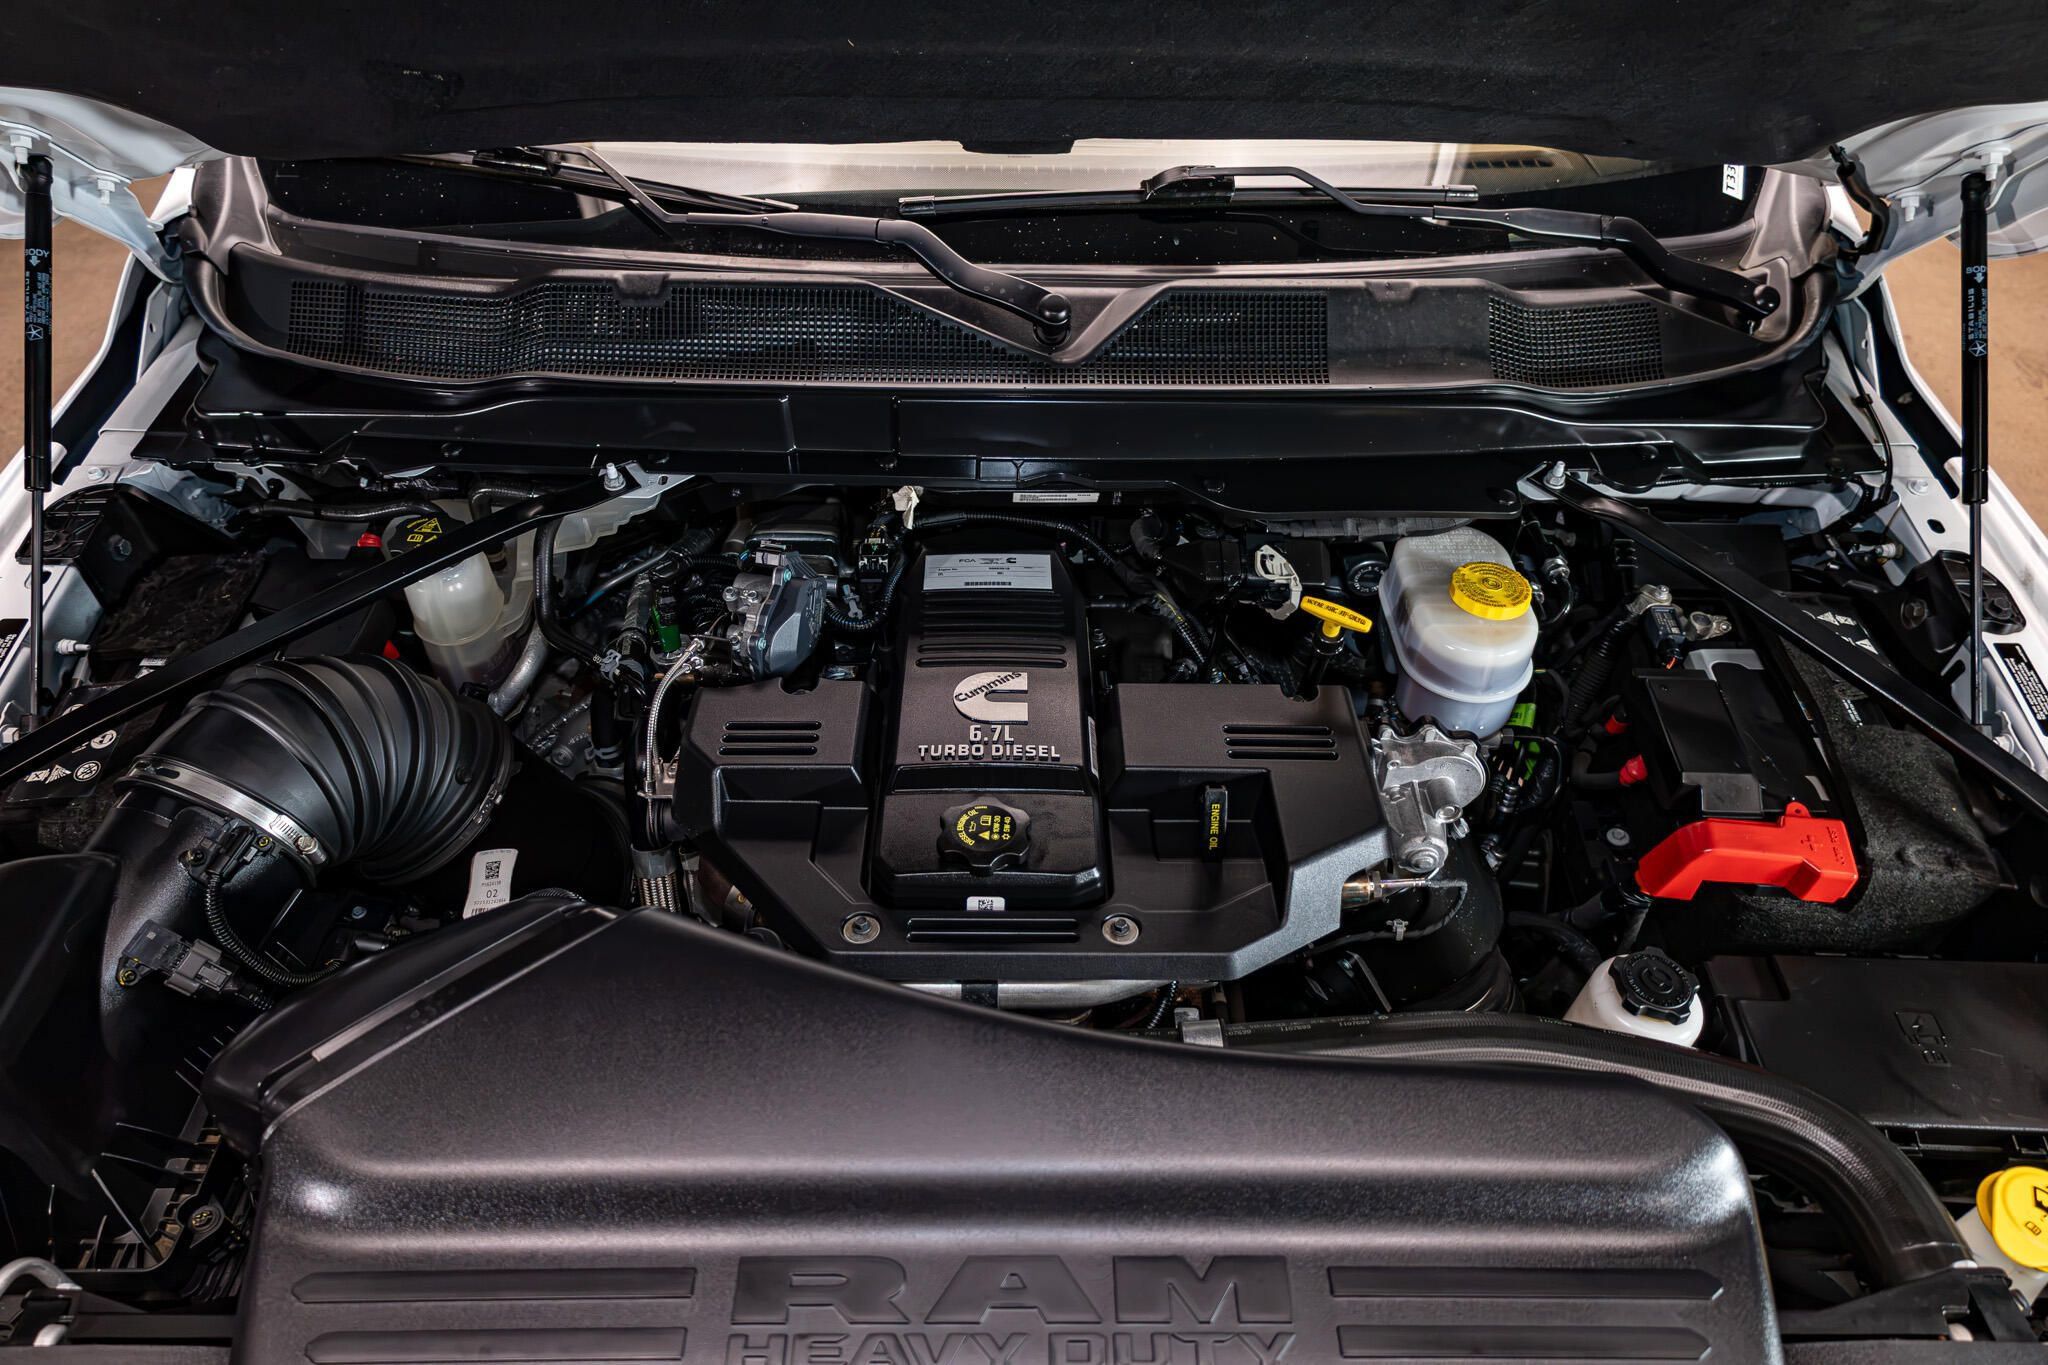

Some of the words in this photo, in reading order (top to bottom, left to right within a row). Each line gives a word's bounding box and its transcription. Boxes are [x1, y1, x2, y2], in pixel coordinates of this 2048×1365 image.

[954, 671, 1022, 702] Cummins
[970, 725, 1014, 742] 6.7L
[918, 744, 984, 759] TURBO
[991, 744, 1060, 760] DIESEL
[957, 814, 970, 831] ENGINE
[967, 809, 979, 817] OIL
[1210, 803, 1220, 835] ENGINE
[1209, 836, 1218, 850] OIL
[486, 889, 498, 899] 02
[730, 1255, 1294, 1325] RAM
[726, 1332, 1029, 1365] HEAVY
[1048, 1332, 1297, 1365] DUTY
